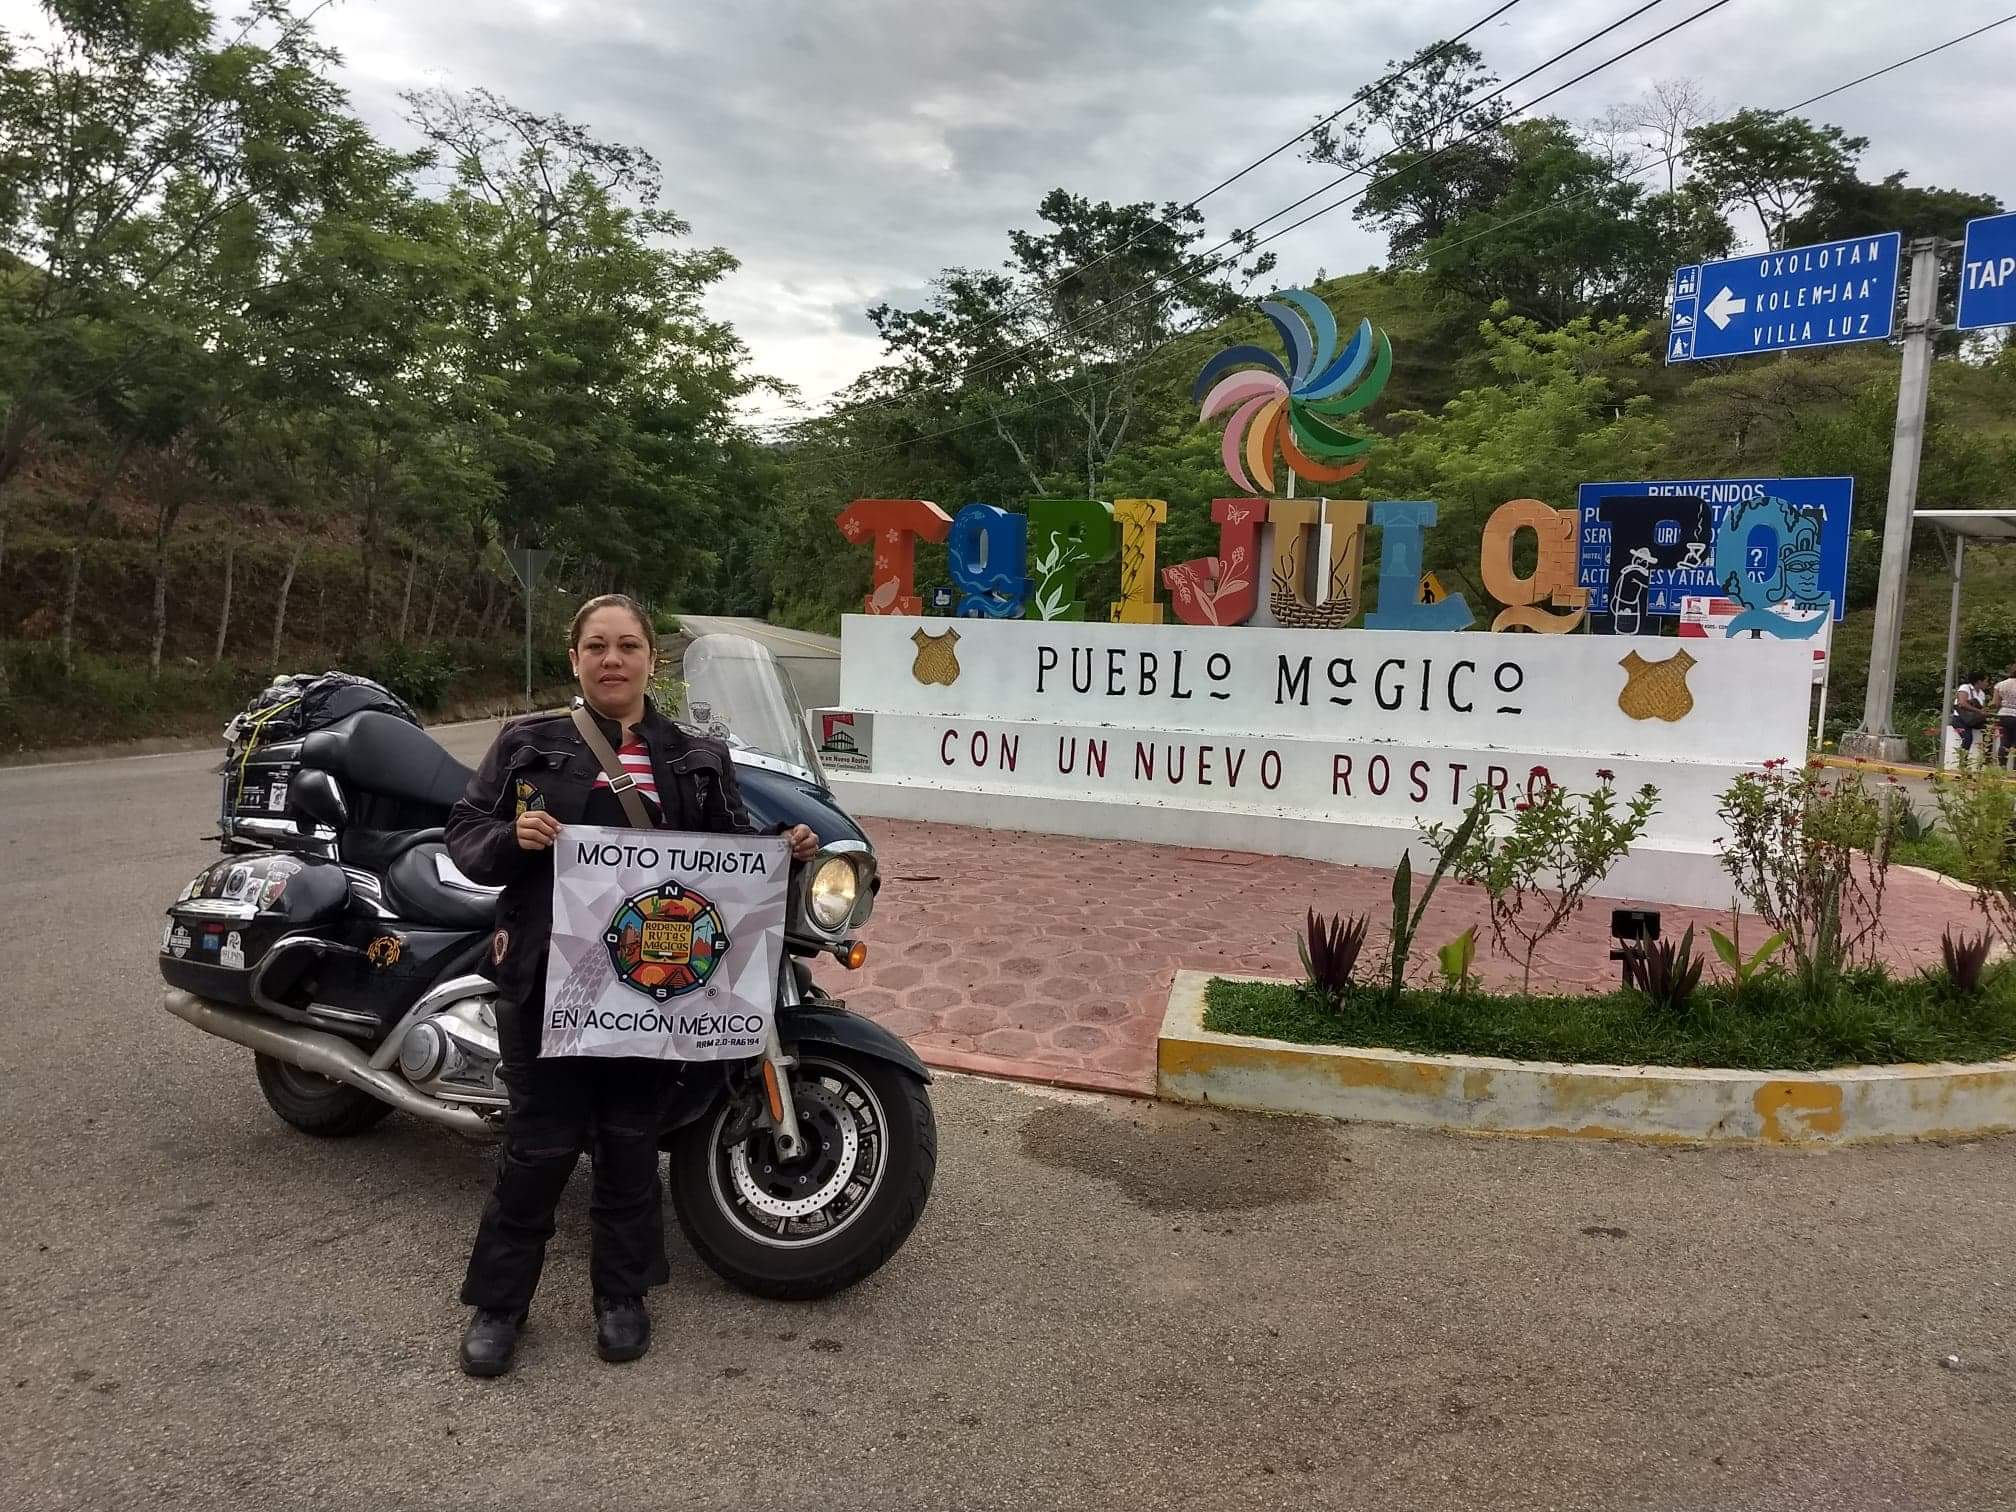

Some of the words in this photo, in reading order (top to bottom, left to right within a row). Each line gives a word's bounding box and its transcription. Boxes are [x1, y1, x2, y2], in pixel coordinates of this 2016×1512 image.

[1760, 241, 1880, 278] OXOLOTAN
[1753, 320, 1812, 346] VILLA
[1828, 314, 1870, 337] LUZ
[1648, 484, 1766, 503] BIENVENIDOS
[940, 729, 1019, 772] CON
[1058, 736, 1107, 778] UN
[1135, 741, 1282, 790] NUEVO
[577, 842, 659, 869] MOTO
[667, 849, 767, 875] TURISTA
[665, 886, 678, 896] N
[715, 940, 726, 950] E
[656, 988, 667, 998] S
[551, 1009, 578, 1029] EN
[583, 1009, 674, 1034] ACCIÓN
[679, 1012, 763, 1036] MÉXICO
